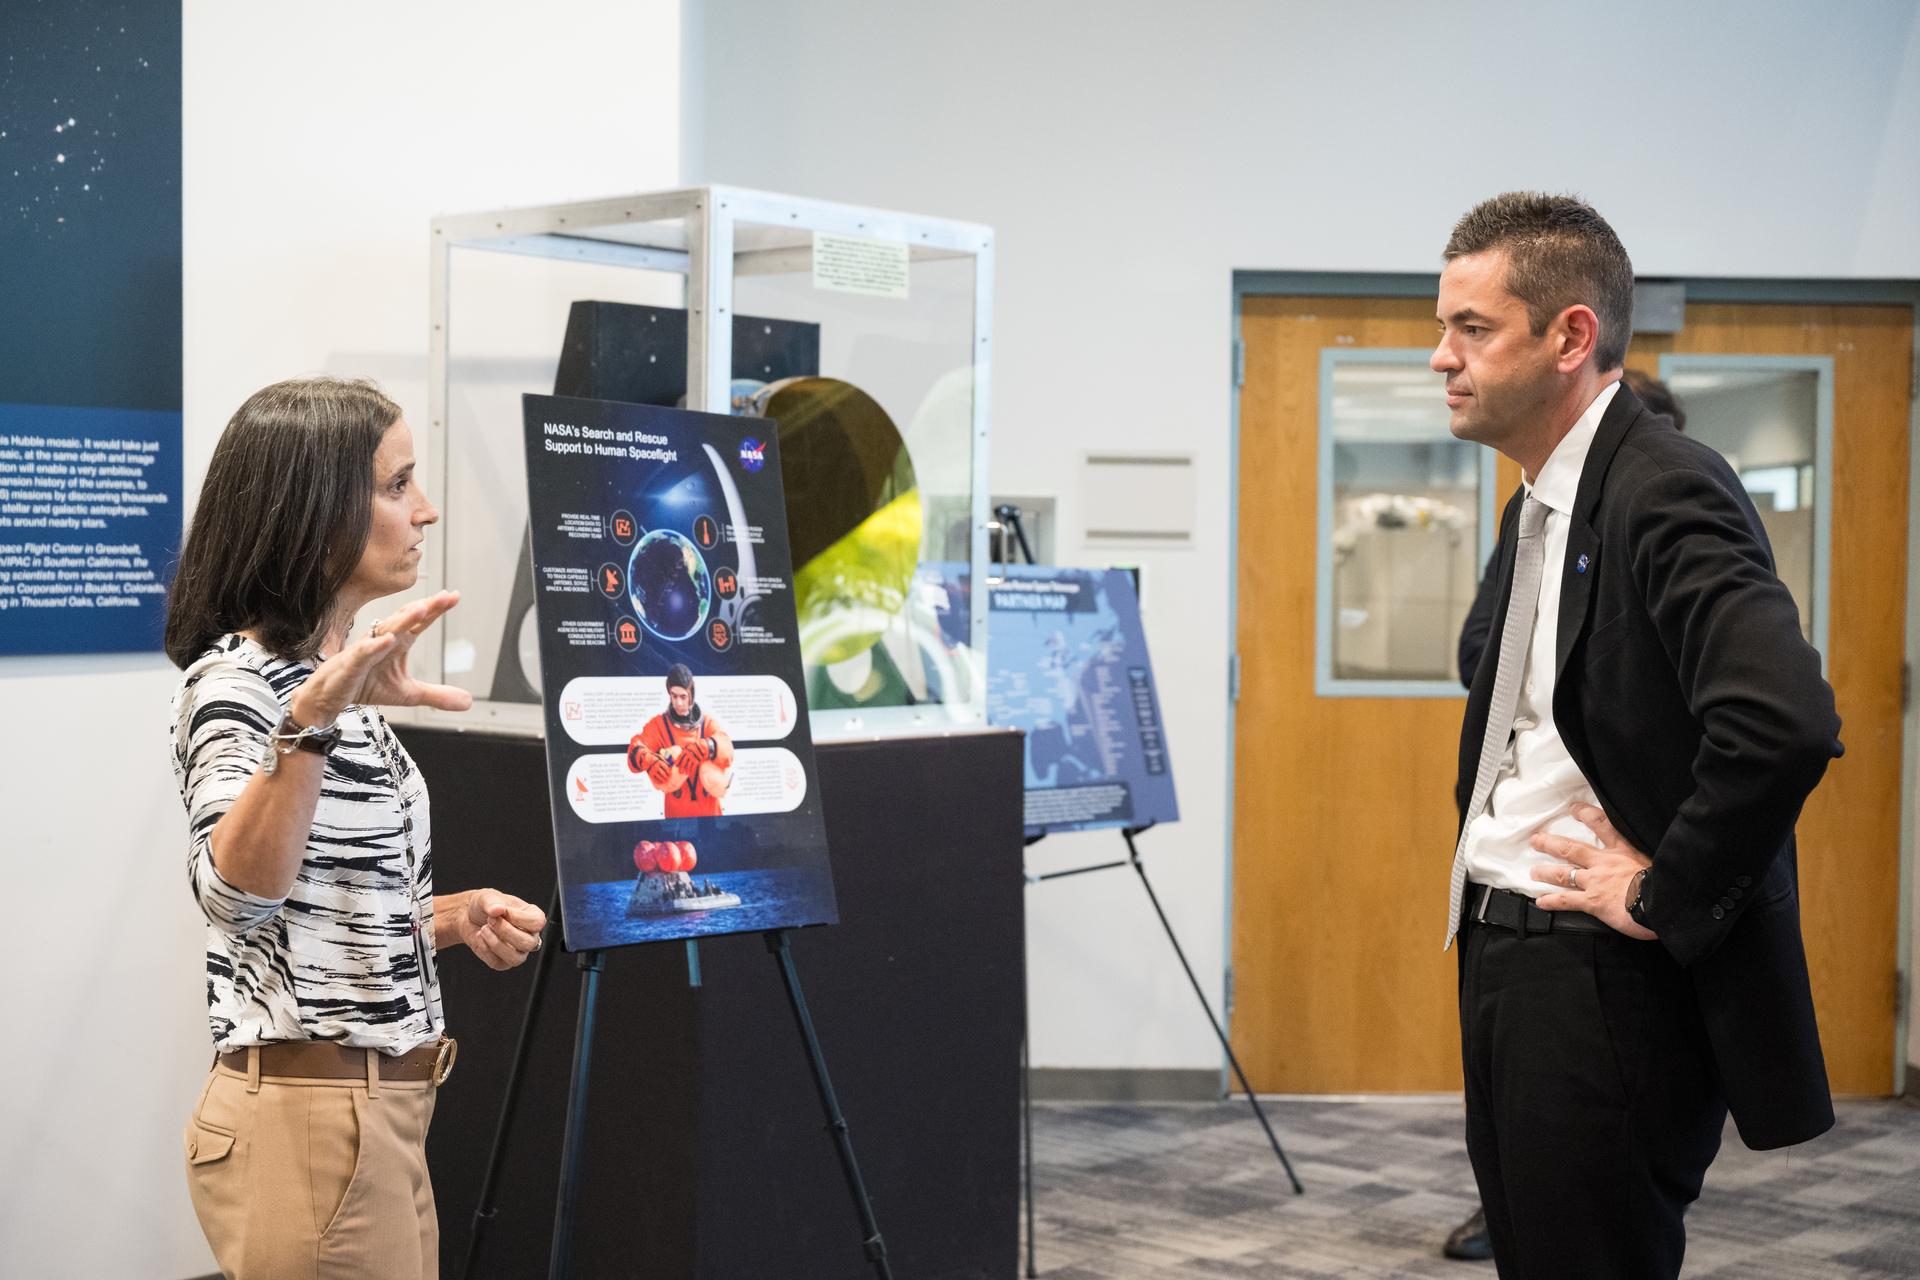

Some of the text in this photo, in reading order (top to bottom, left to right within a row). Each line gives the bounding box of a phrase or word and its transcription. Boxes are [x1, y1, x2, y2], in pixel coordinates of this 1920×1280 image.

[544, 422, 669, 446] NASA's Search and Rescue
[11, 434, 45, 448] Hubble
[84, 437, 91, 449] It
[93, 438, 120, 450] would
[121, 439, 142, 451] take
[142, 440, 160, 453] just
[24, 450, 34, 461] at
[36, 449, 51, 461] the
[53, 452, 78, 462] same
[80, 451, 107, 464] depth
[108, 452, 126, 463] and
[127, 453, 155, 467] image
[545, 438, 678, 464] Support to Human Spaceflight
[741, 449, 764, 460] NASA
[19, 462, 34, 474] will
[36, 463, 67, 475] enable
[69, 465, 76, 475] a
[77, 466, 97, 478] very
[98, 465, 143, 477] ambitious
[35, 477, 65, 490] history
[68, 477, 78, 489] of
[79, 478, 94, 490] the
[137, 479, 148, 490] to
[11, 490, 52, 502] missions
[54, 490, 66, 503] by
[68, 491, 120, 504] discovering
[121, 491, 168, 504] thousands
[2, 503, 31, 514] stellar
[32, 503, 50, 515] and
[52, 504, 88, 517] galactic
[14, 517, 47, 528] around
[49, 517, 80, 530] nearby
[24, 542, 51, 556] Flight
[52, 542, 84, 555] Center
[85, 543, 94, 554] in
[32, 556, 42, 567] in
[43, 556, 86, 568] Southern
[133, 556, 149, 568] the
[12, 570, 56, 581] scientists
[57, 569, 80, 581] from
[81, 570, 114, 581] various
[115, 570, 155, 581] research
[17, 582, 73, 596] Corporation
[74, 583, 83, 594] in
[10, 597, 19, 608] in
[21, 595, 68, 608] Thousand
